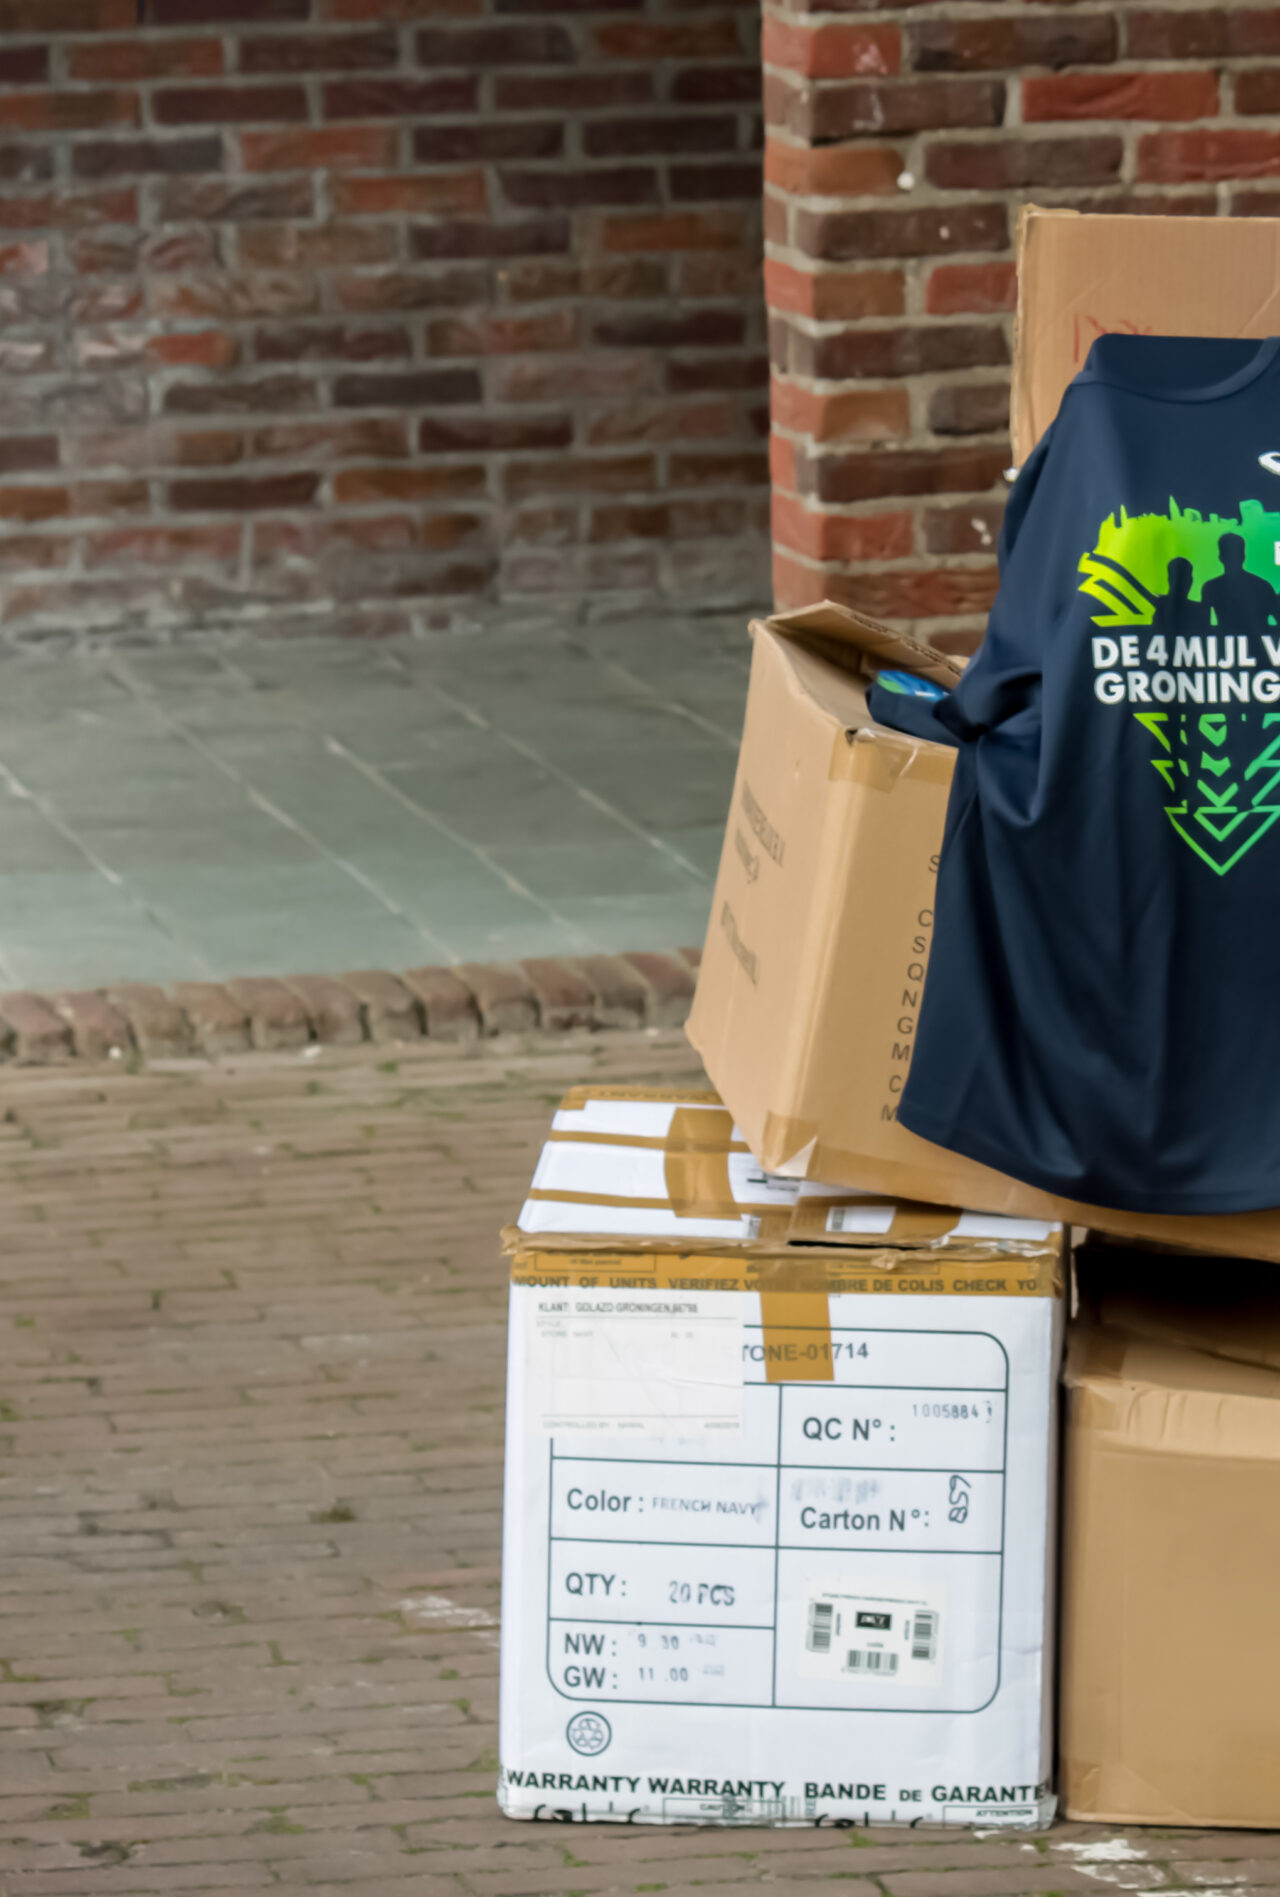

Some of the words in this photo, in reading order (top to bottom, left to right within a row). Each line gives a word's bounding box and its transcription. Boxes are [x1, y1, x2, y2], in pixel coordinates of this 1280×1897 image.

[1092, 635, 1140, 669] DE
[1146, 635, 1168, 666] 4
[1173, 635, 1256, 668] MIJL
[579, 1276, 598, 1288] OF
[609, 1277, 657, 1289] UNITS
[668, 1278, 739, 1291] VERIFIEZ
[873, 1279, 892, 1291] DE
[898, 1279, 944, 1292] COLIS
[953, 1280, 1007, 1292] CHECK
[803, 1417, 842, 1440] QC
[653, 1497, 711, 1512] FRENCH
[716, 1501, 758, 1515] NAVY
[801, 1507, 880, 1530] Carton
[669, 1580, 691, 1604] 20
[507, 1770, 640, 1794] WARRANTY
[648, 1777, 785, 1799] WARRANTY
[805, 1782, 886, 1800] BANDE
[900, 1789, 922, 1802] DE
